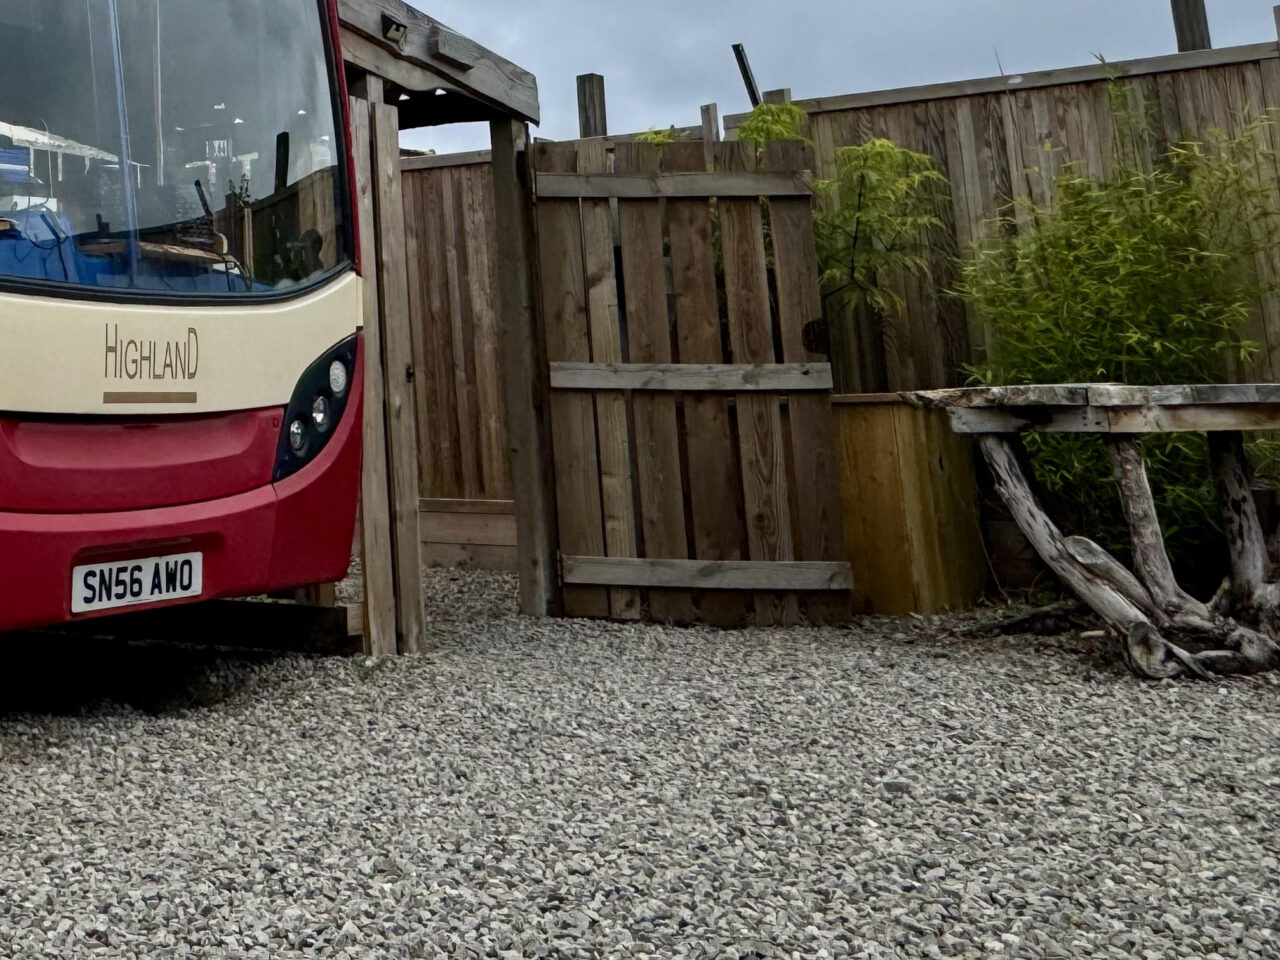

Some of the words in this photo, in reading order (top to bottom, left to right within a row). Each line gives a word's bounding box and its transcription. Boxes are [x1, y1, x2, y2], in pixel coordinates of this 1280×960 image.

[105, 323, 199, 380] HIGHLAND
[83, 565, 143, 604] SN56
[150, 559, 193, 596] AWO
